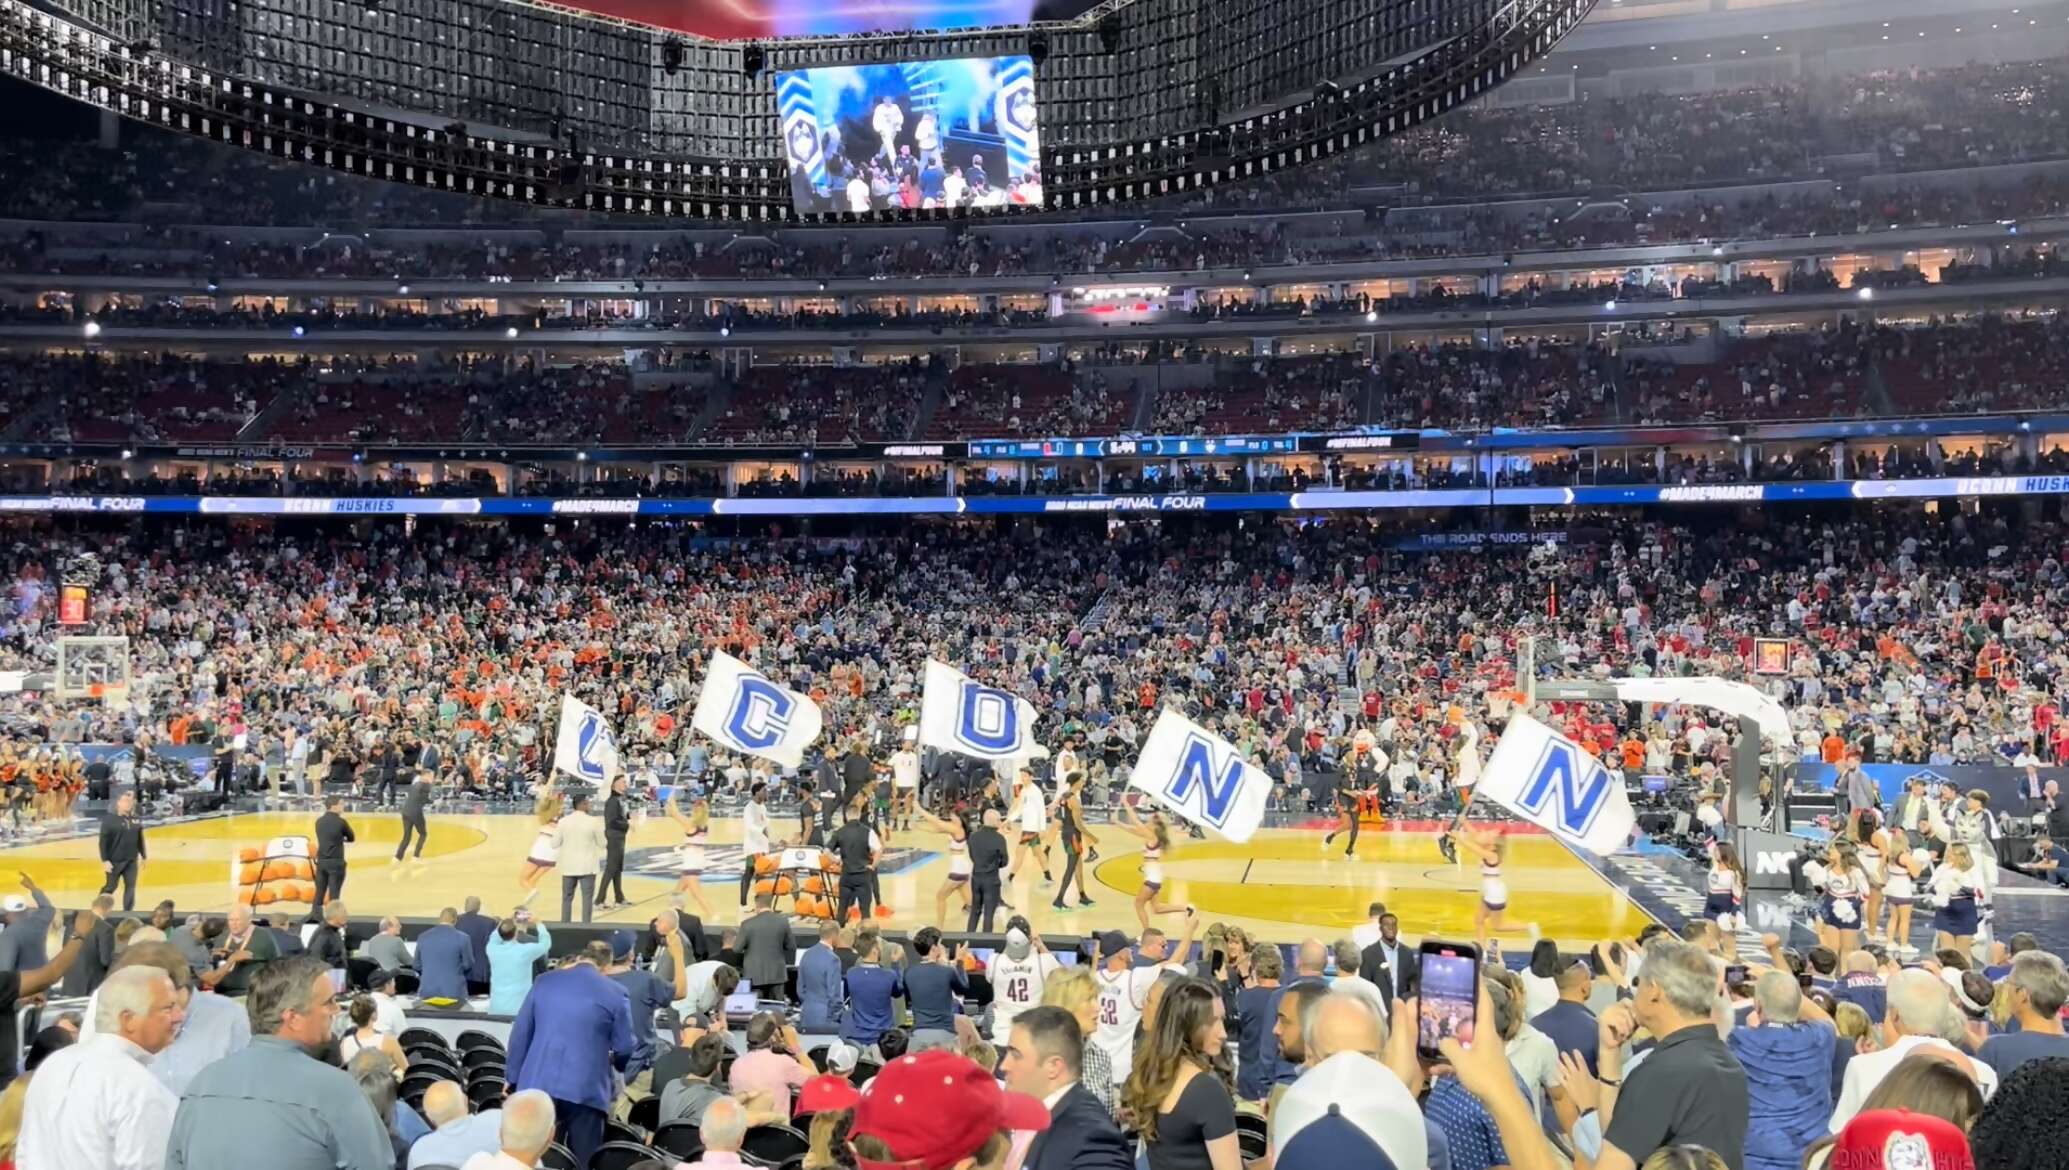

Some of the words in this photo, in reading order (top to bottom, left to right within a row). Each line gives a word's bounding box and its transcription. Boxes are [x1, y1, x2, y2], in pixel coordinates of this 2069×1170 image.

[237, 447, 274, 457] FINAL
[279, 447, 313, 457] FOUR
[1659, 485, 1764, 501] #MADE4MARCH
[1957, 477, 2017, 494] UCONN
[50, 497, 97, 510] FINAL
[100, 497, 146, 510] FOUR
[336, 499, 395, 511] HUSKIES
[552, 499, 640, 513] #MADE4MARCH
[1112, 497, 1159, 509] FINAL
[1161, 496, 1206, 509] FOUR
[1421, 534, 1446, 544] THE
[1449, 533, 1486, 544] ROAD
[1490, 532, 1528, 543] ENDS
[1532, 532, 1567, 542] HERE
[721, 673, 798, 750] C
[953, 679, 1022, 755] O
[1165, 731, 1246, 829] N
[1516, 735, 1613, 838] N
[1007, 978, 1029, 1002] 42
